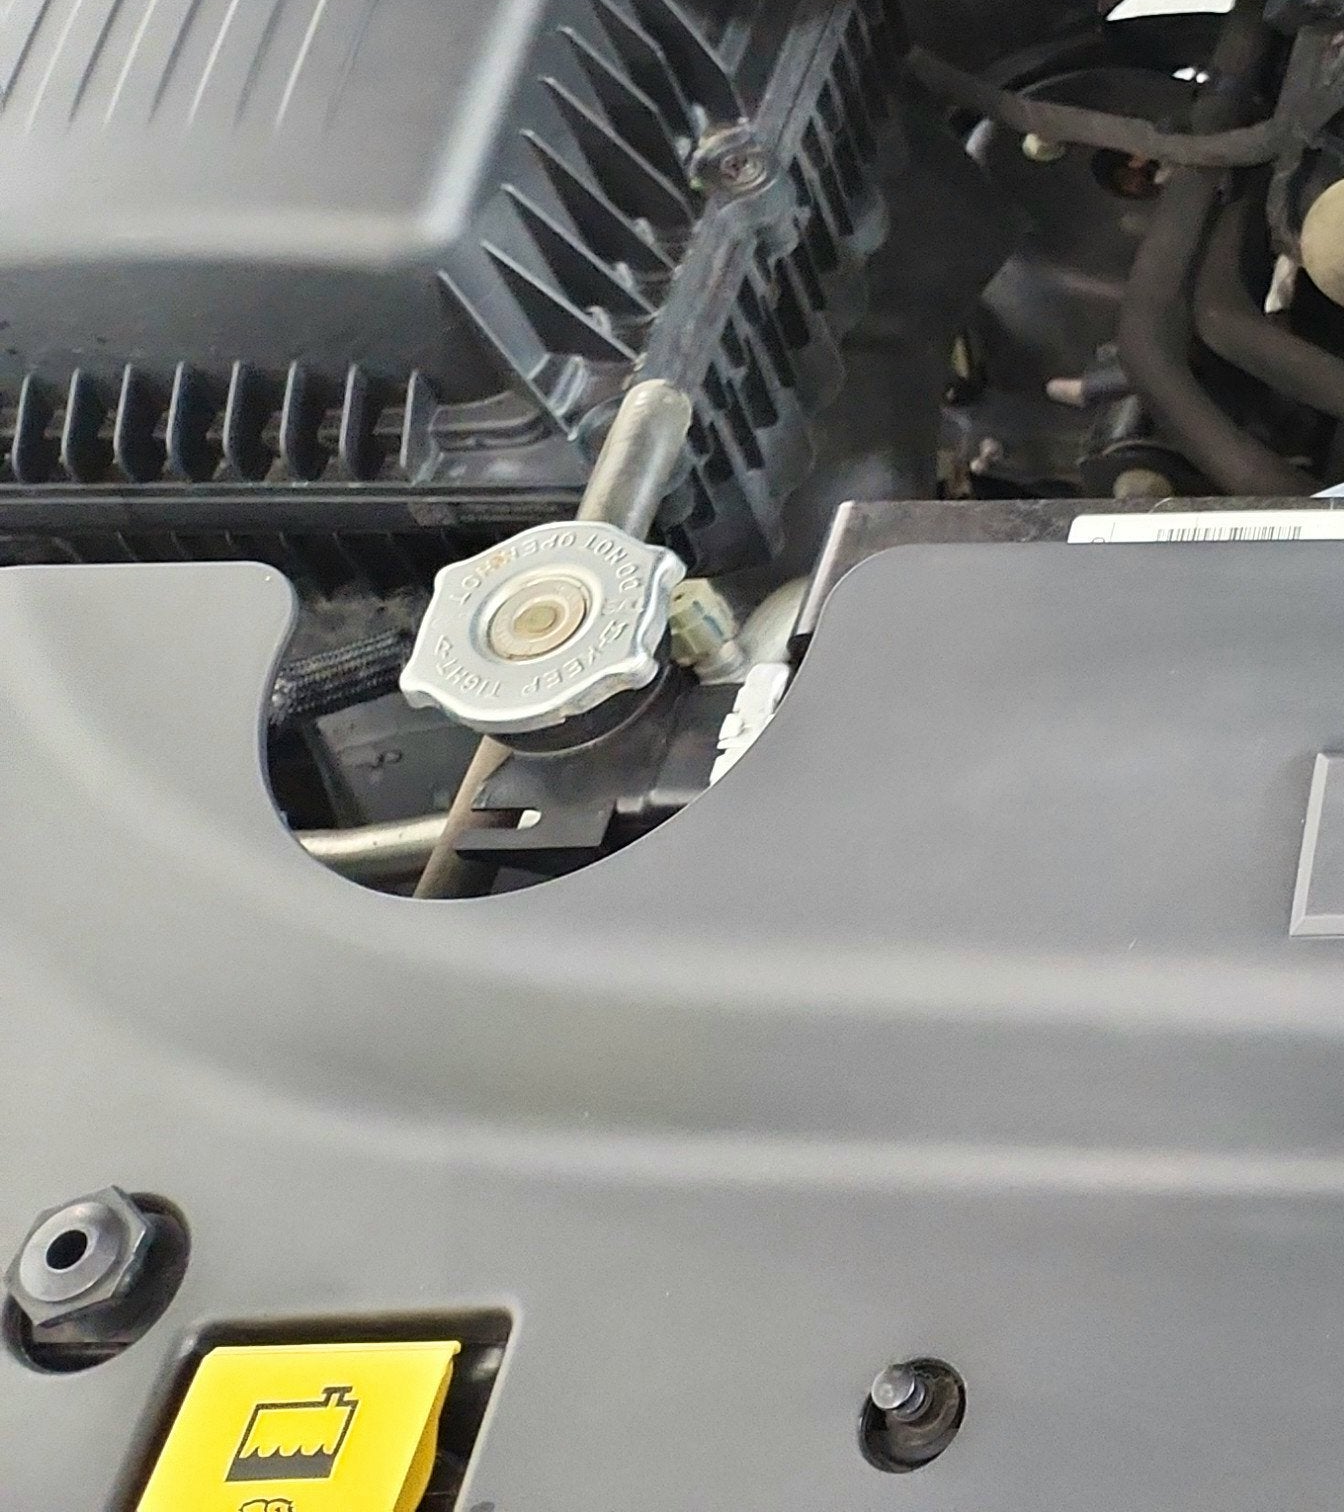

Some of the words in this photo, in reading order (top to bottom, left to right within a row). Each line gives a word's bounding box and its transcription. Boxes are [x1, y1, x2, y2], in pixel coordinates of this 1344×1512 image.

[582, 535, 631, 568] NOT
[613, 560, 645, 594] DO
[436, 657, 503, 699] TIGHT
[521, 648, 600, 698] KEEP
